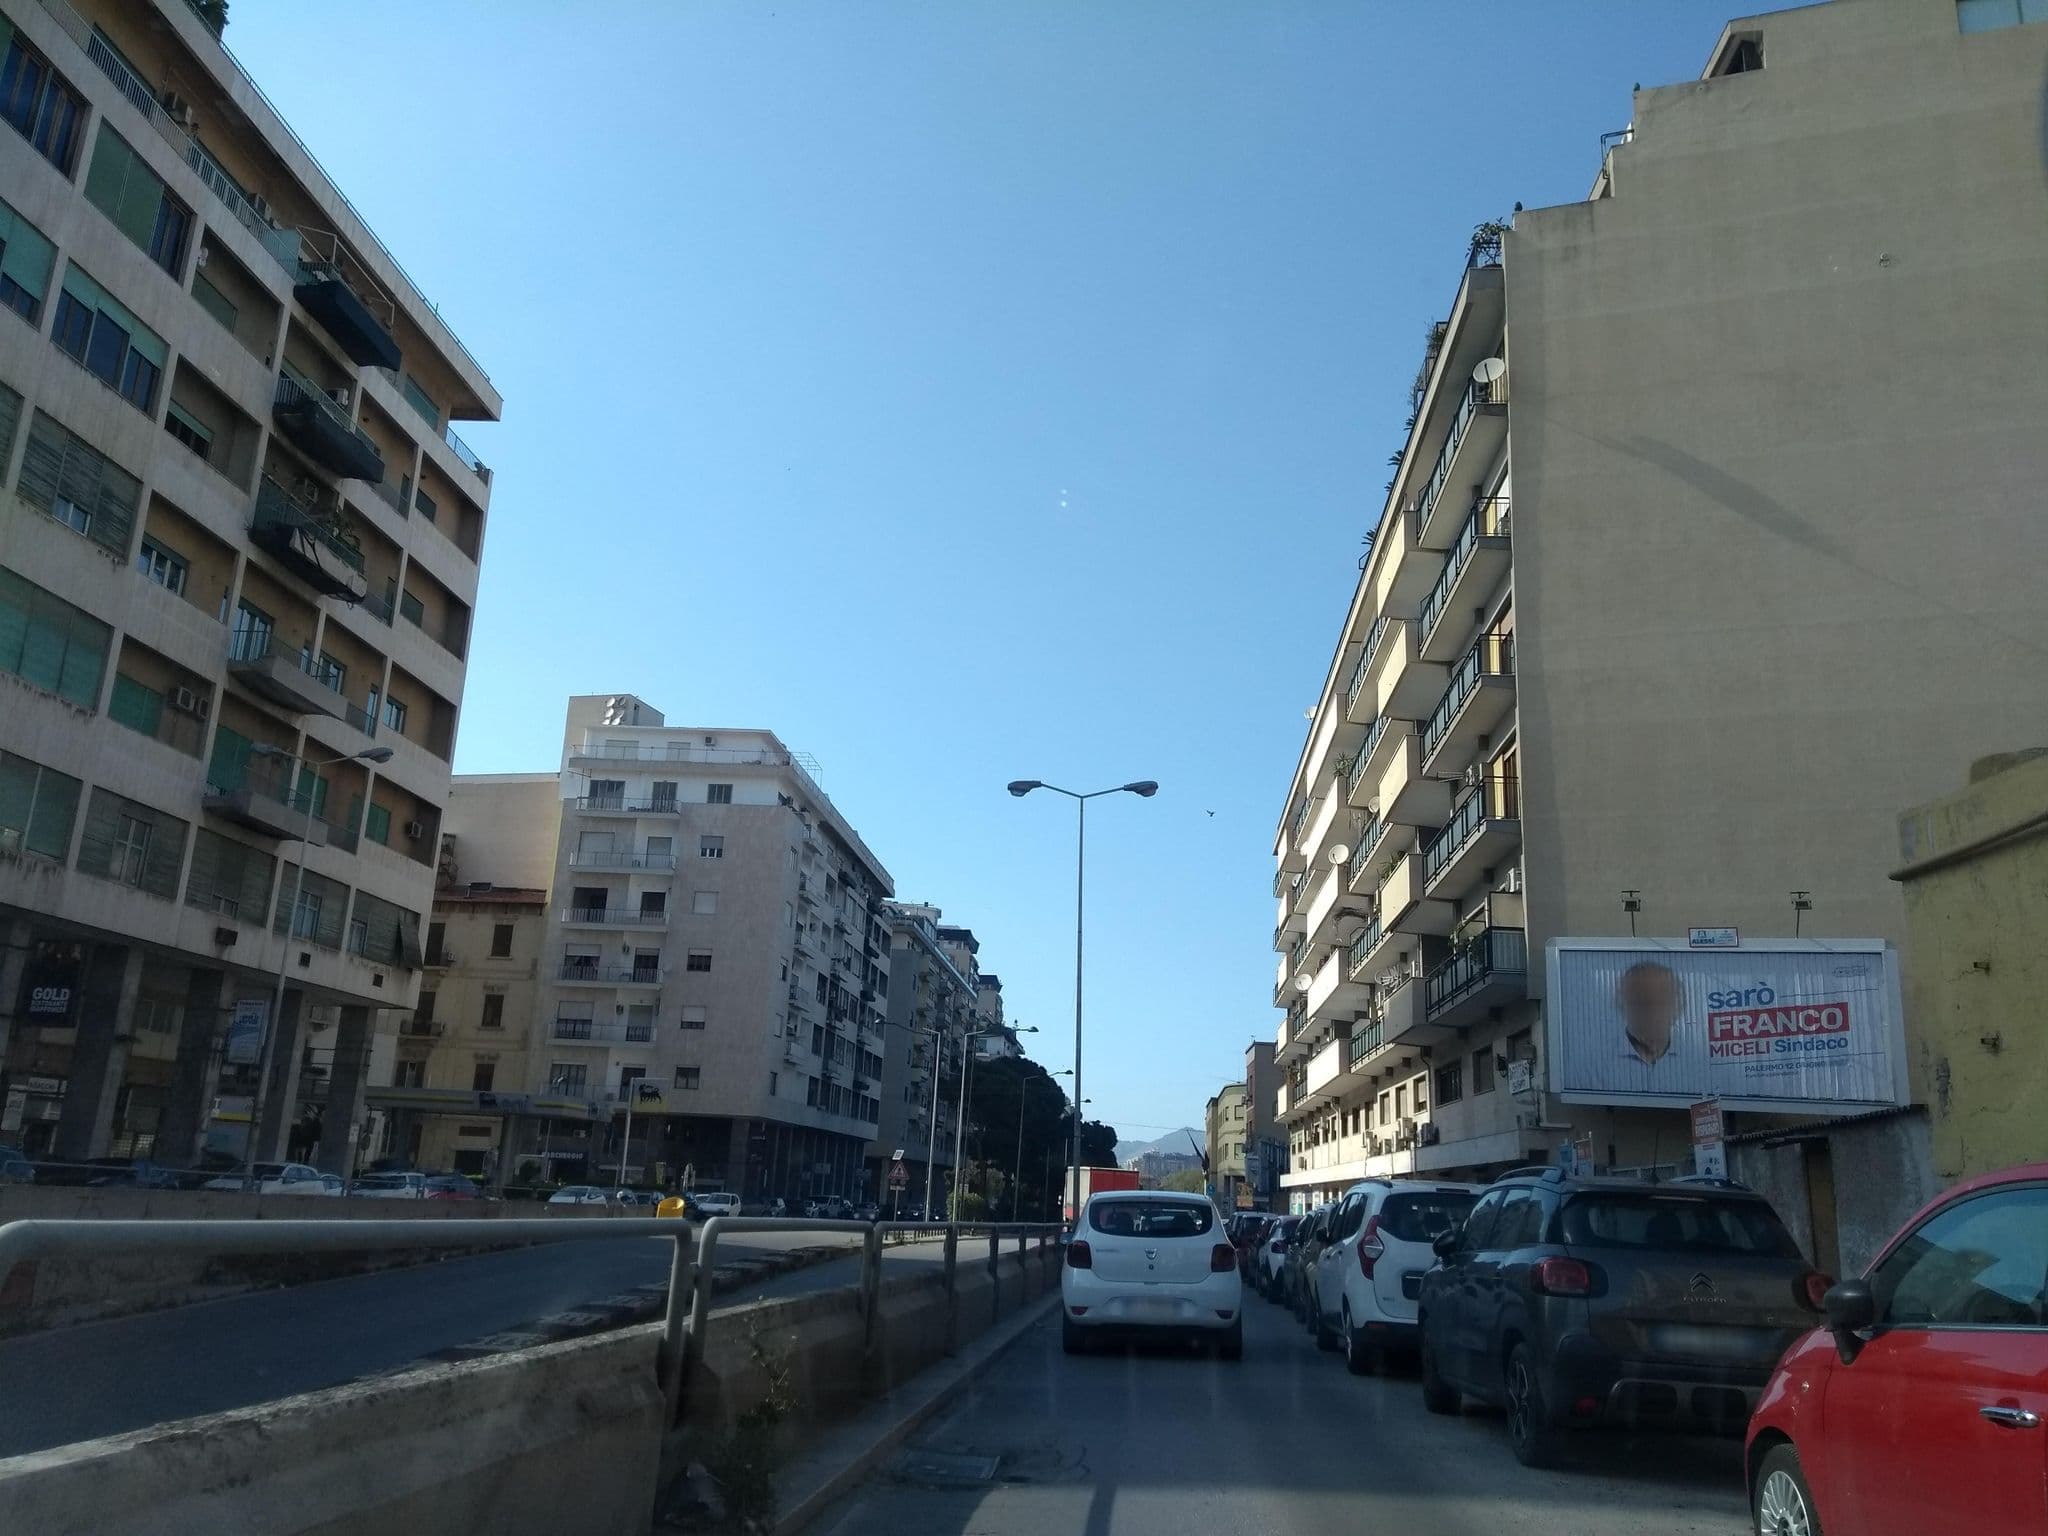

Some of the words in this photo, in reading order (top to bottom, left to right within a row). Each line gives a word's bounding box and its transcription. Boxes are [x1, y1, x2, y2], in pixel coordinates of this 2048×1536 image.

[32, 987, 70, 1001] GOLD
[1708, 982, 1775, 1009] sarò
[1713, 1007, 1843, 1038] FRANCO
[1710, 1040, 1770, 1058] MICELI
[1775, 1037, 1848, 1053] Sindaco
[1744, 1063, 1784, 1073] PALERMO
[1785, 1062, 1795, 1070] 12
